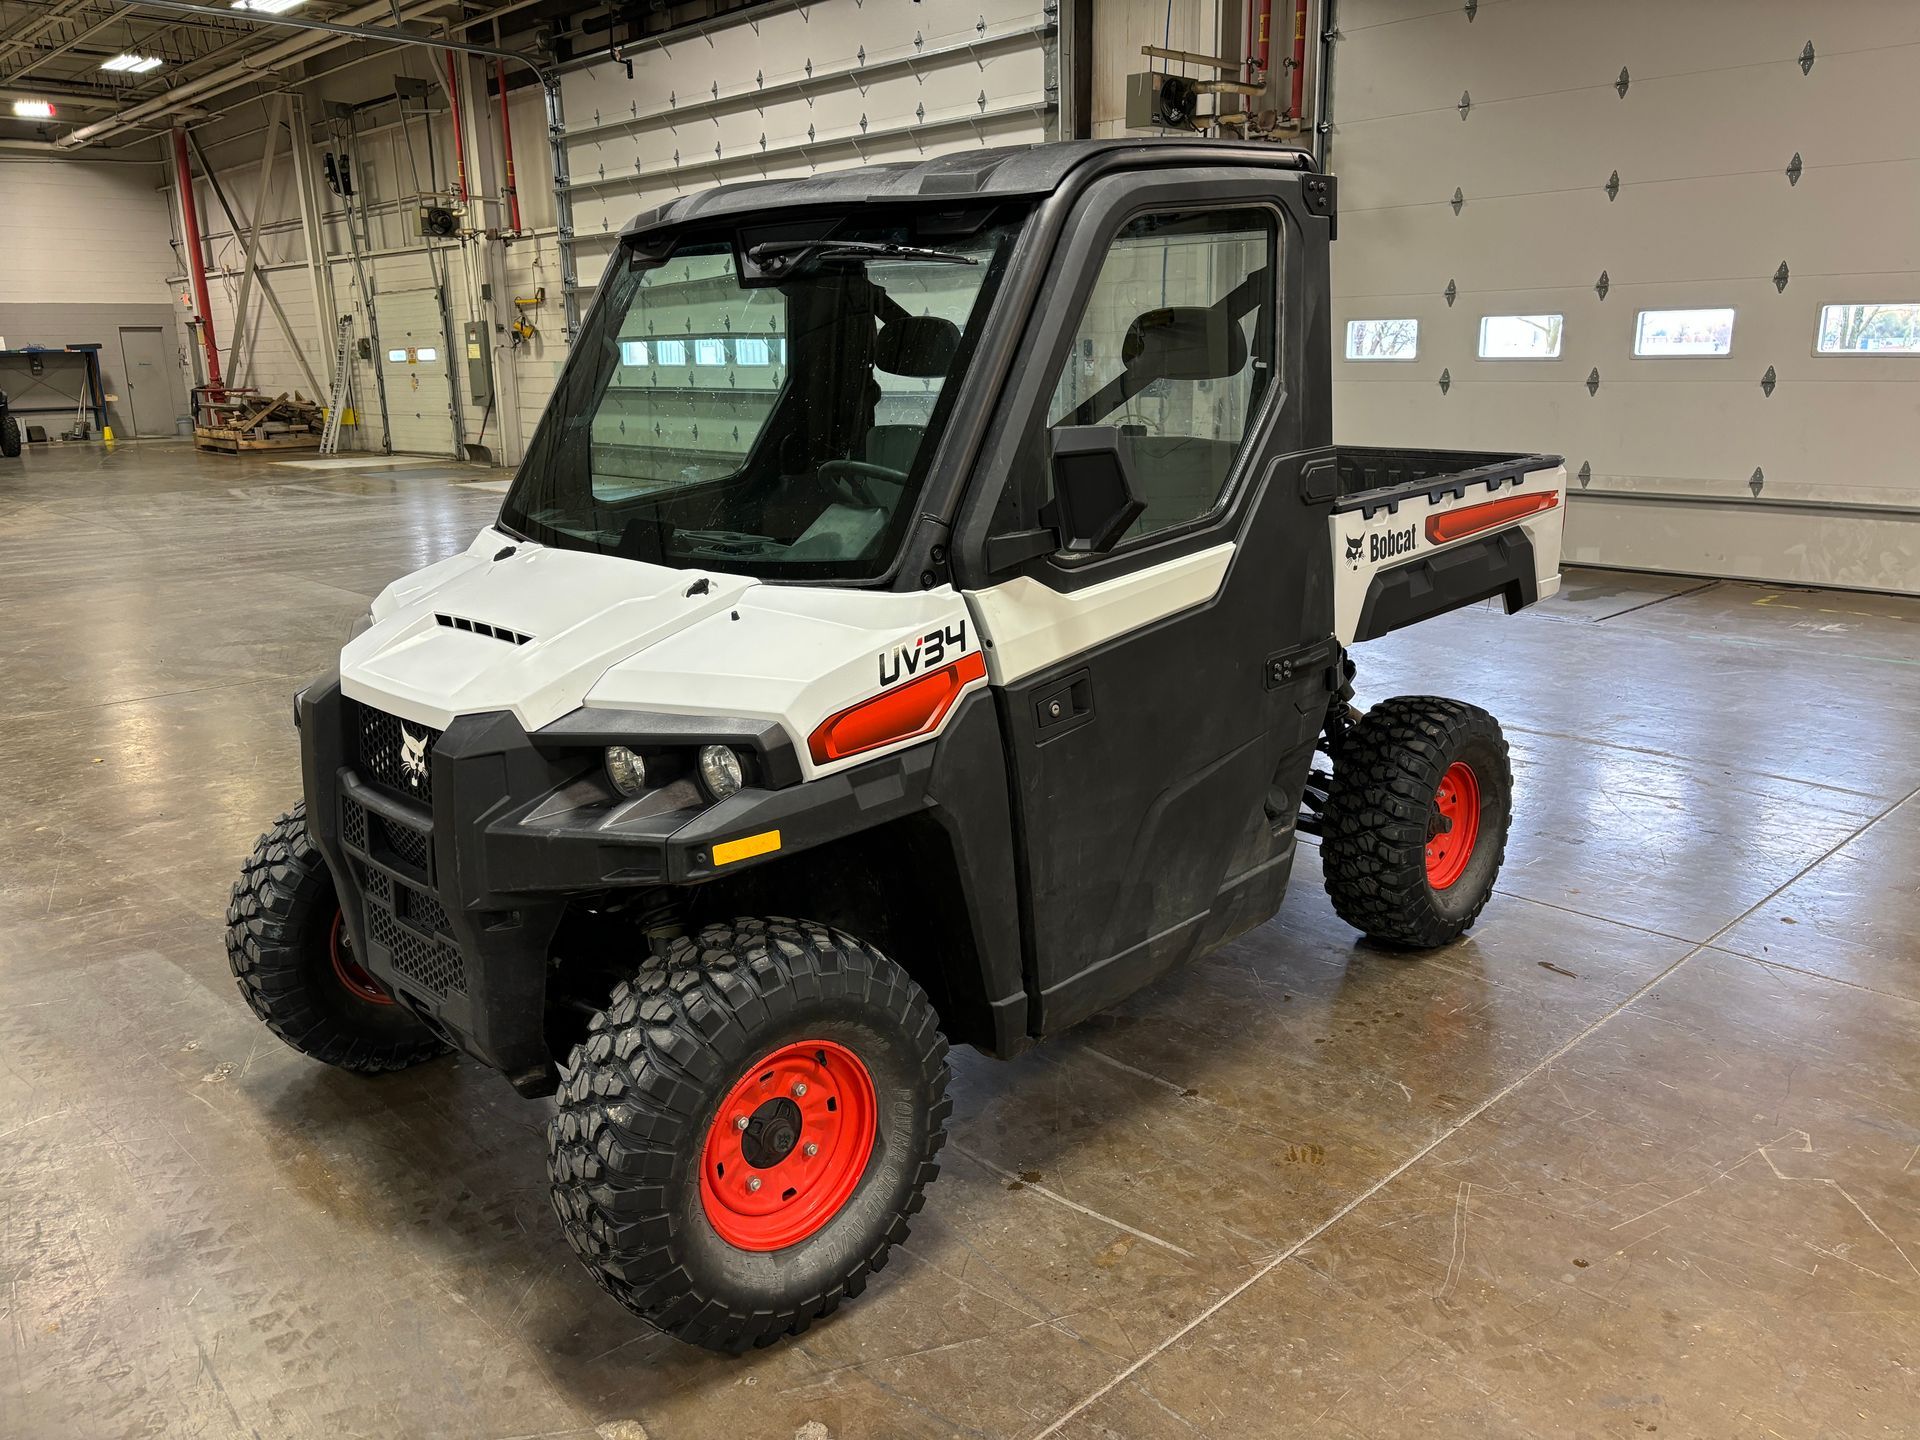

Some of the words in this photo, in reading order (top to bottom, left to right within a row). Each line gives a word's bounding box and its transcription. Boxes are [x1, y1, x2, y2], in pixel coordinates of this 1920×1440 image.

[1370, 523, 1416, 562] Bobcat
[879, 620, 966, 687] UV34
[889, 1088, 913, 1163] POWER
